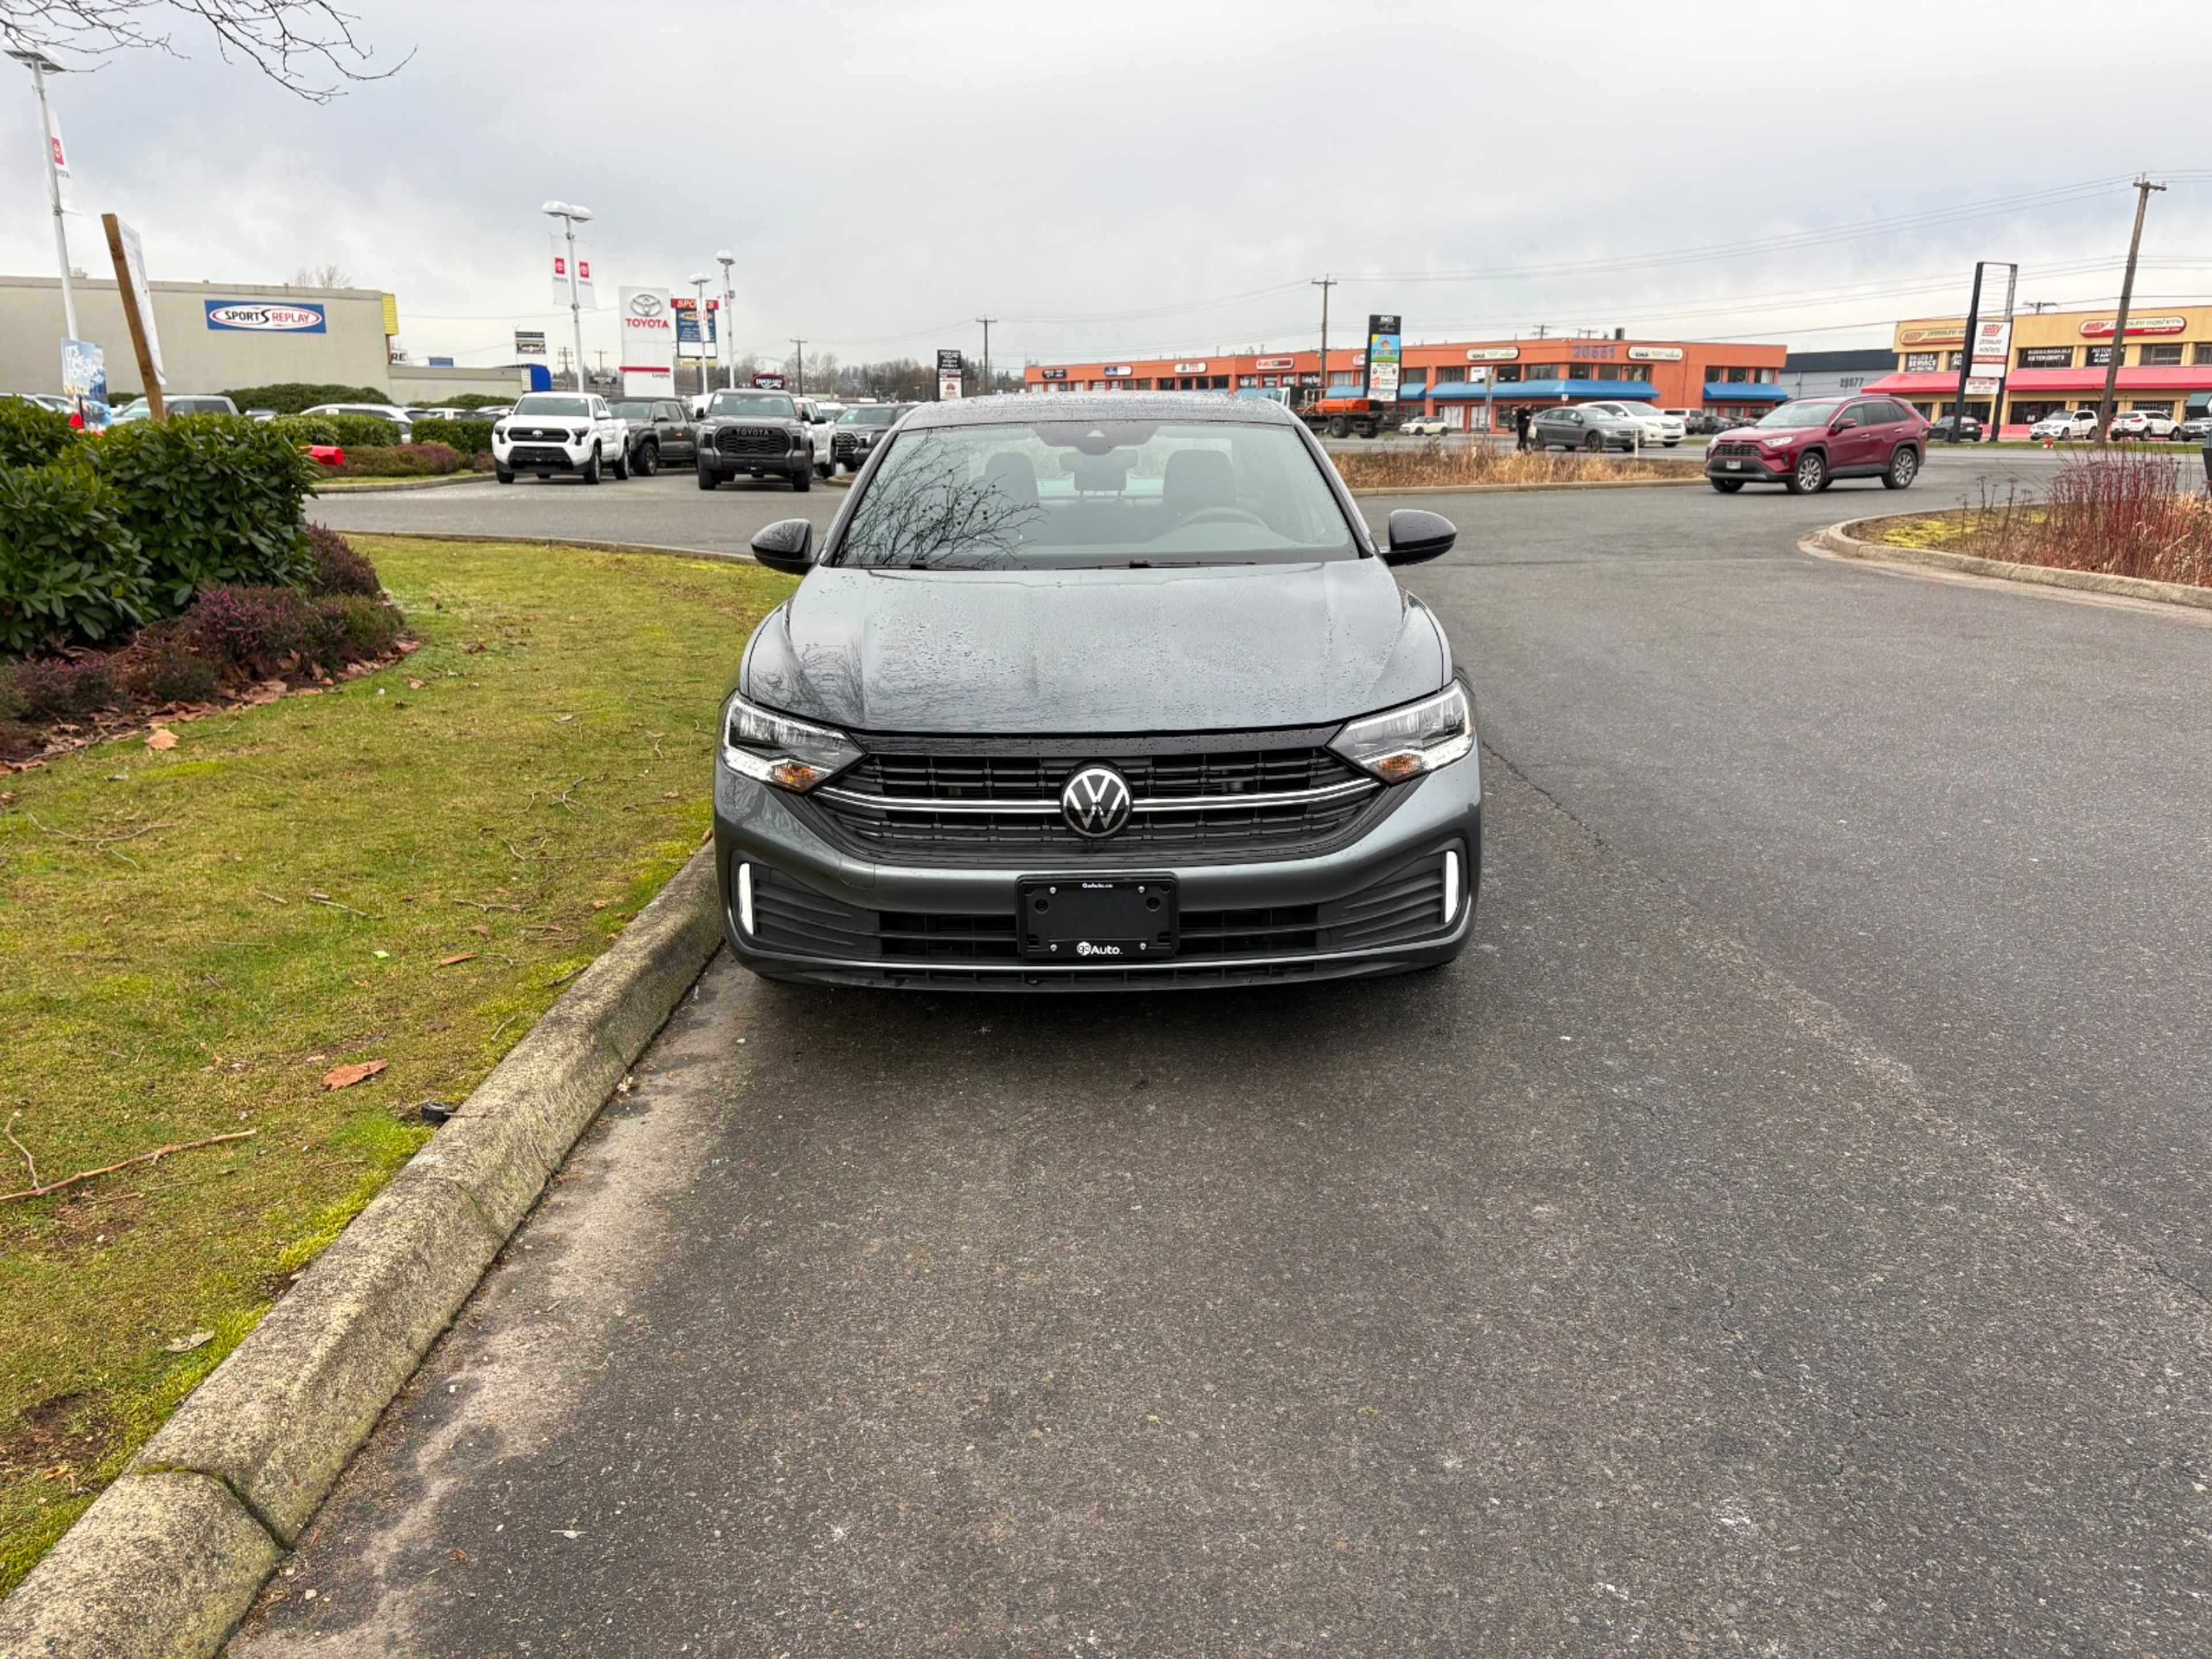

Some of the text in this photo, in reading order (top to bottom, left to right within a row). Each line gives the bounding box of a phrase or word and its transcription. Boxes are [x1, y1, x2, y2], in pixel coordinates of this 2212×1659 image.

[677, 300, 714, 308] SPOS
[225, 309, 309, 324] SPORTS REPLAY
[626, 318, 669, 328] TOYOTA
